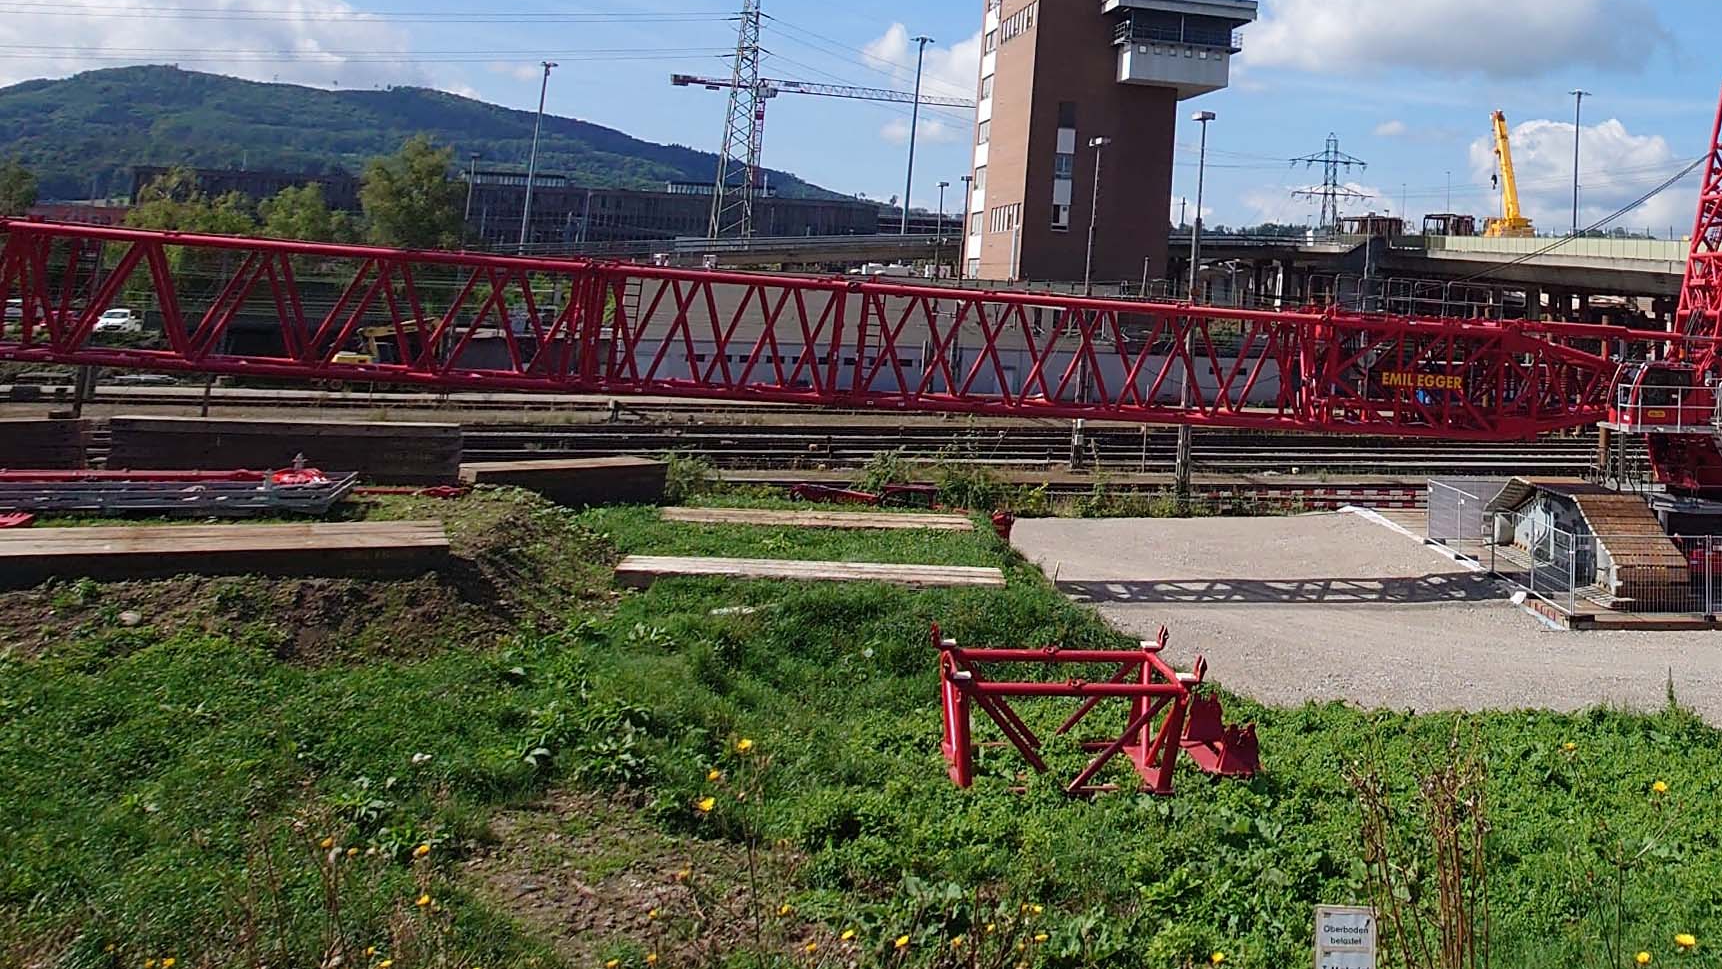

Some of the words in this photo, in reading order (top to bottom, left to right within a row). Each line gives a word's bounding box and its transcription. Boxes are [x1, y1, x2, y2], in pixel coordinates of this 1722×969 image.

[1382, 371, 1413, 386] EMIL
[1417, 374, 1462, 389] EGGER
[1323, 924, 1369, 935] Oberboden
